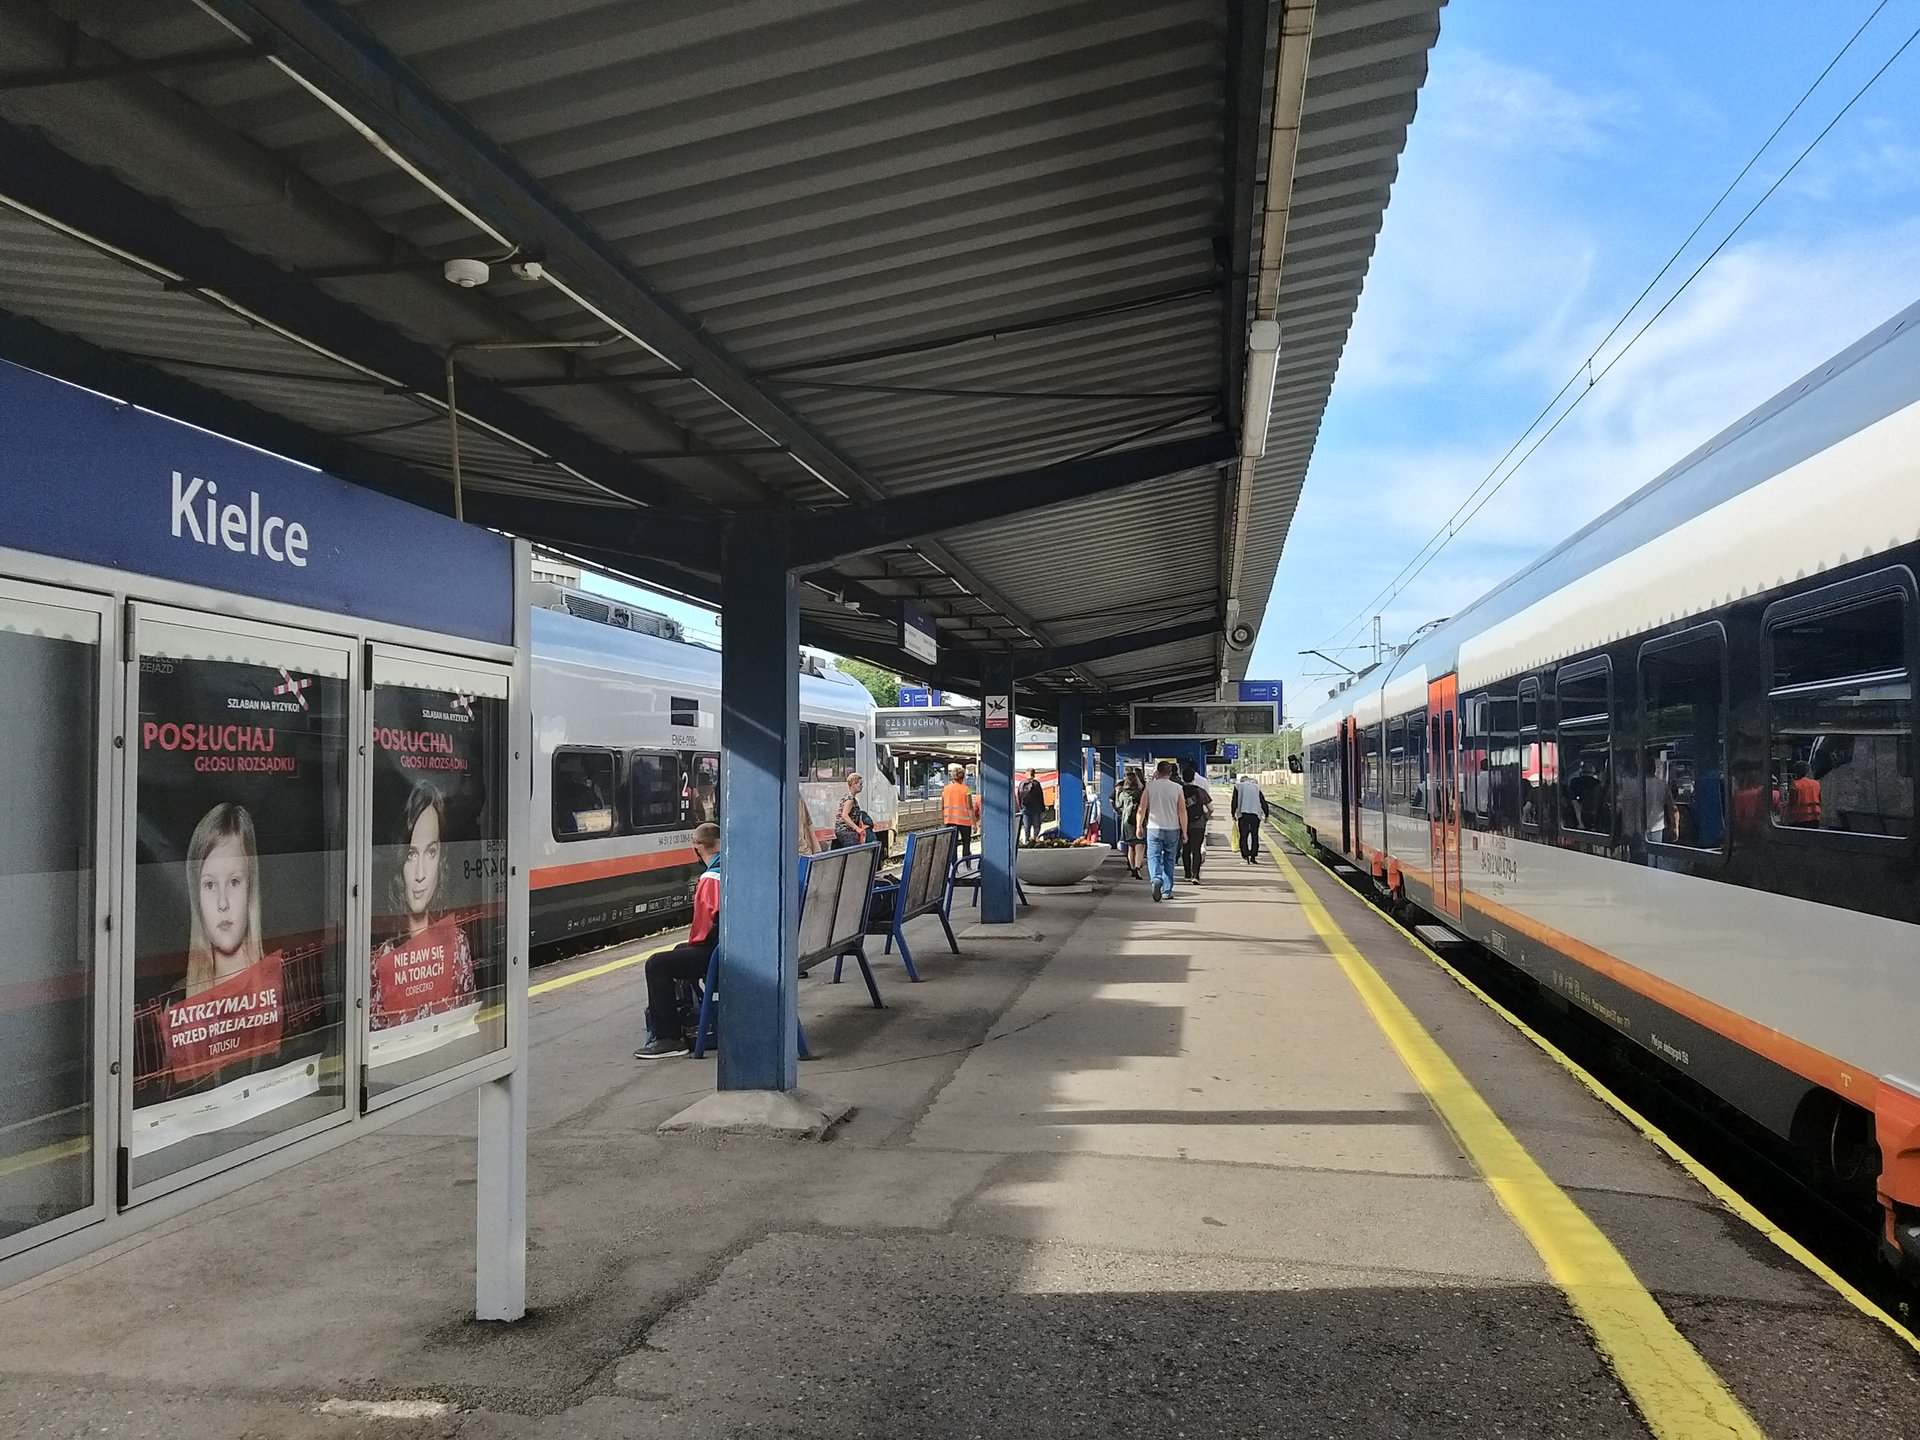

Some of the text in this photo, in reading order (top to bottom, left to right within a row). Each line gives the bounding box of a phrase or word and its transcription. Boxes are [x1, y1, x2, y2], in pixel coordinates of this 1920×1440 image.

[172, 471, 308, 567] Kielce
[903, 693, 910, 703] 3
[1271, 686, 1278, 696] 3
[228, 698, 300, 713] SZLABAN NA RYZYKO!
[443, 711, 450, 720] NA
[143, 722, 275, 752] POSŁUCHAJ
[373, 728, 453, 753] POSŁUCHAJ
[195, 756, 295, 774] GŁOSU ROZSĄDKU
[401, 755, 428, 768] GŁOSU
[681, 771, 689, 797] 2
[394, 945, 444, 969] NIE BAW SIĘ
[394, 963, 444, 986] NA TORACH
[169, 988, 277, 1028] ZATRZYMAJ SIĘ
[171, 1010, 278, 1048] PRZED PRZEJAZDEM
[208, 1037, 240, 1055] TATUSIU
